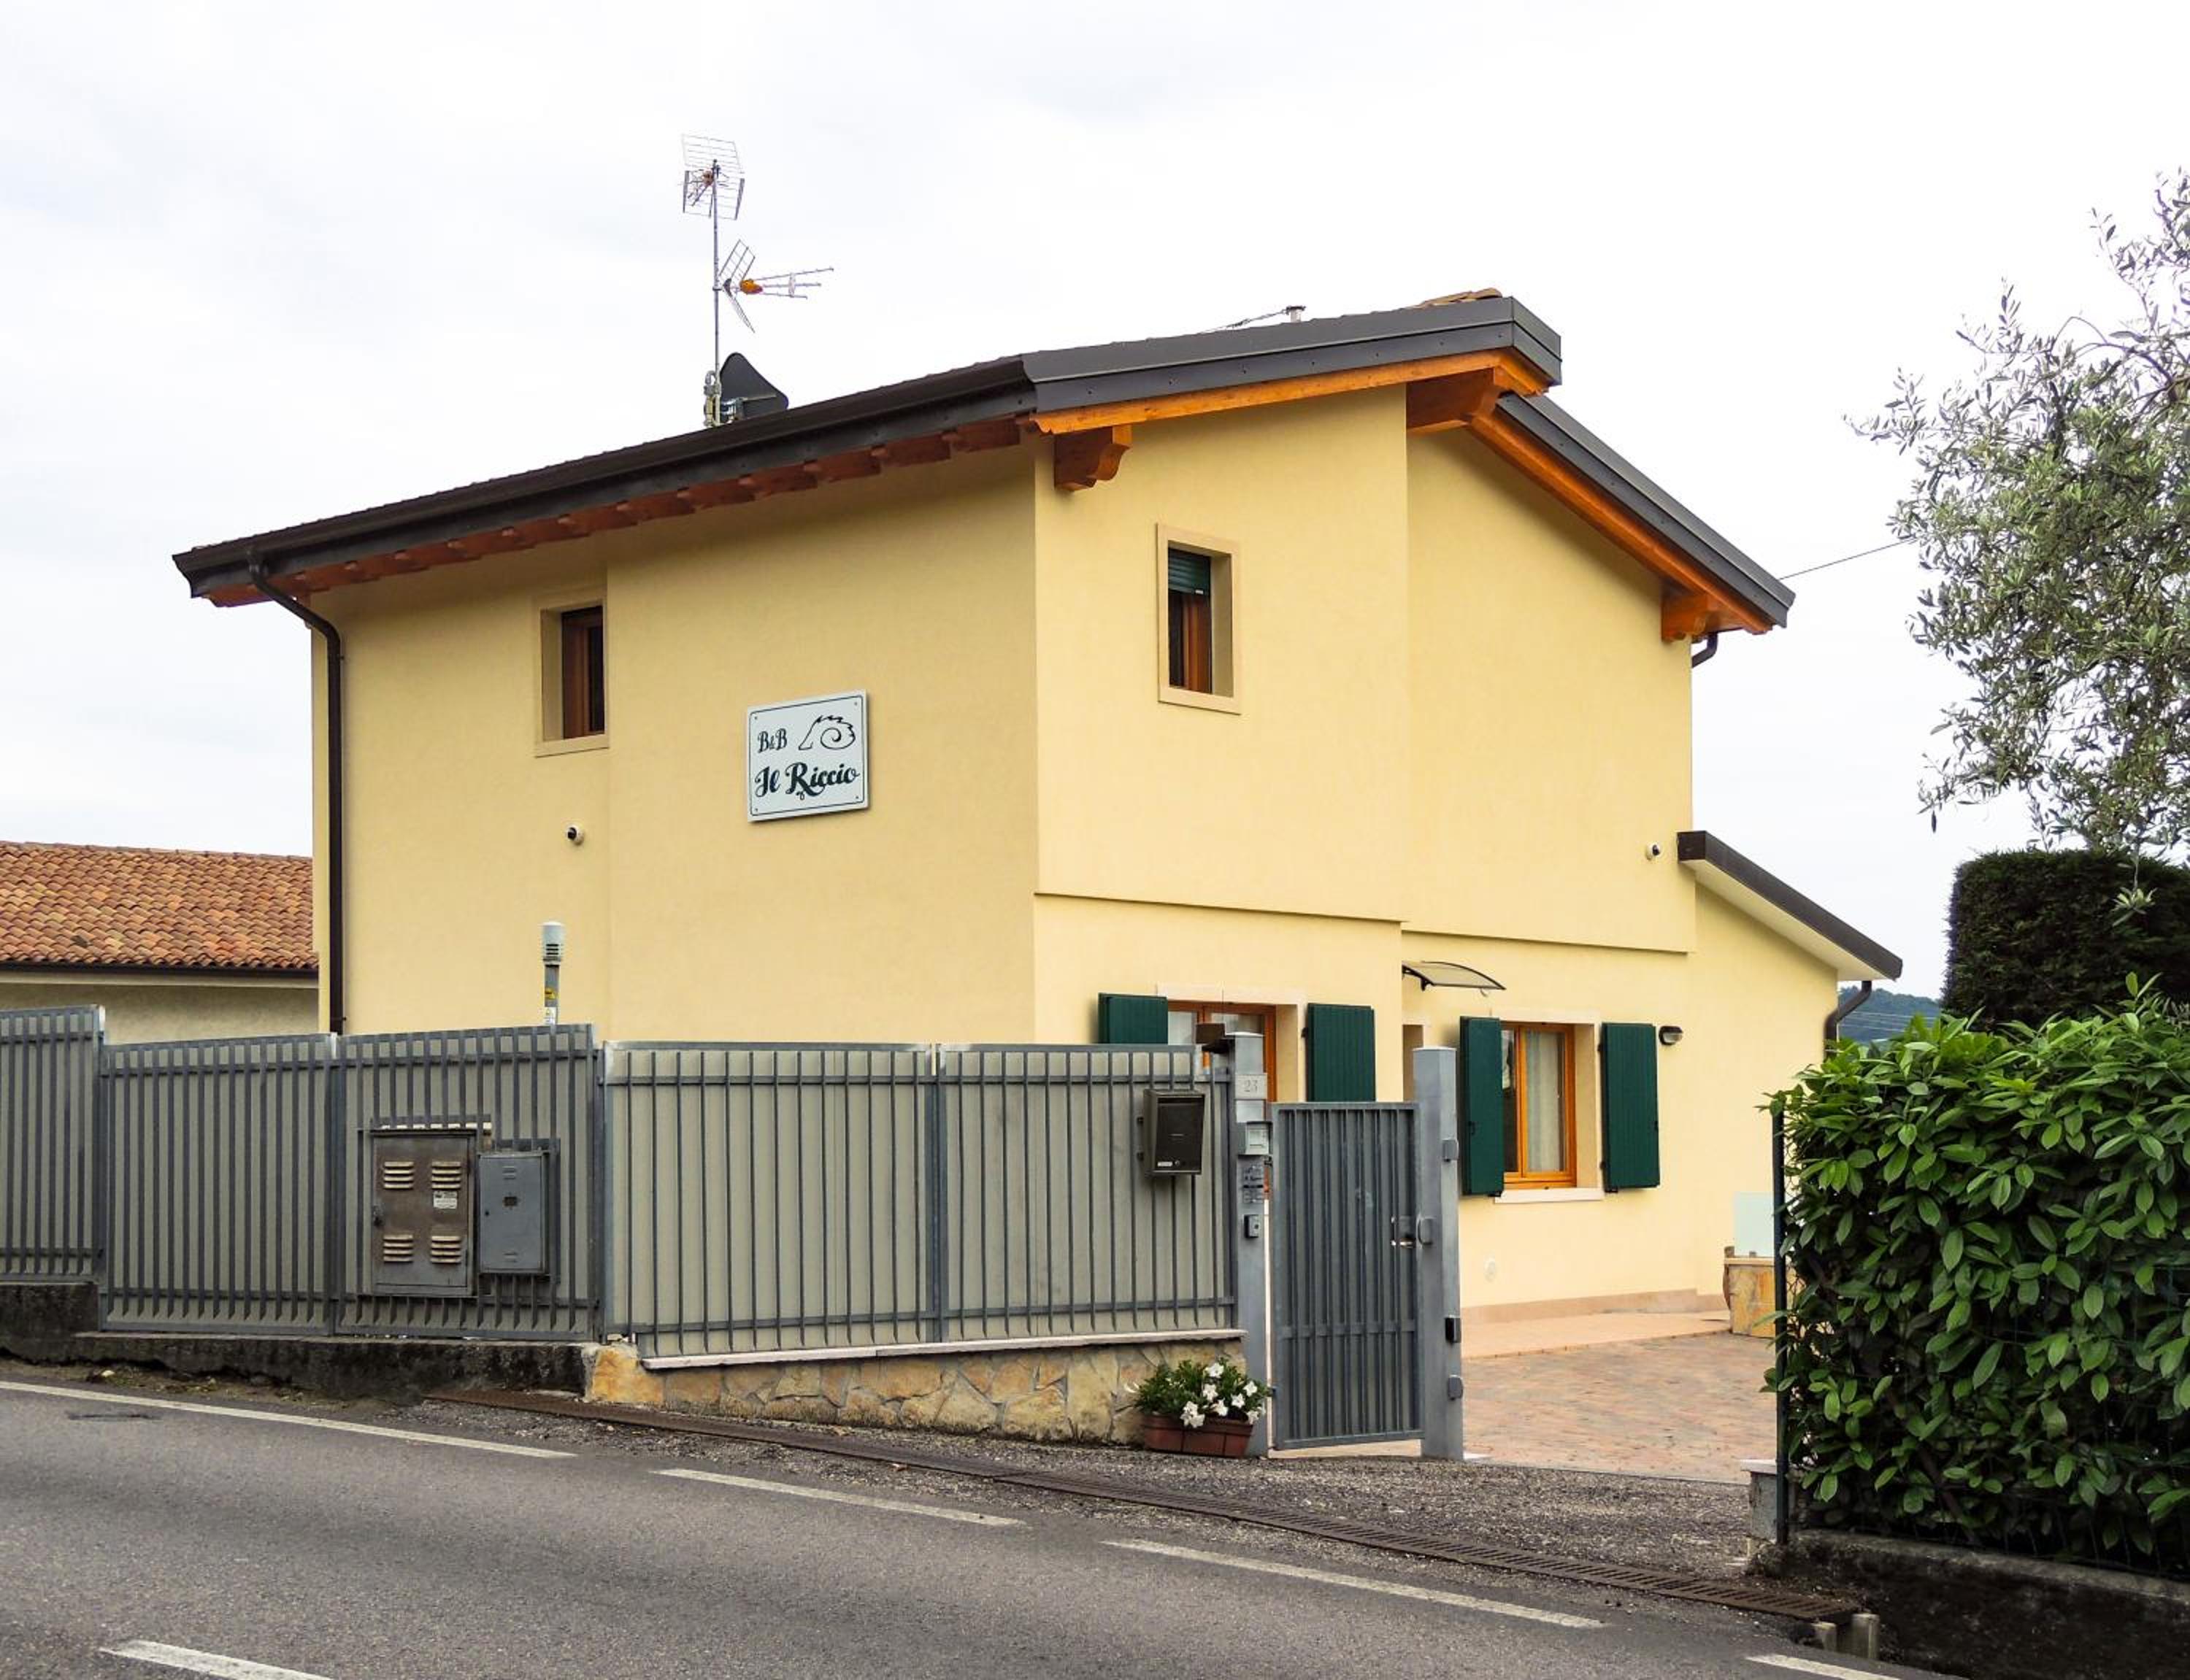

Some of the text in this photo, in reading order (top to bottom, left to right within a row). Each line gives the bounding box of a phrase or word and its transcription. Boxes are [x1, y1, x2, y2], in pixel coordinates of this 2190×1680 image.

[757, 728, 788, 753] B&B
[755, 761, 860, 800] Il Riccio
